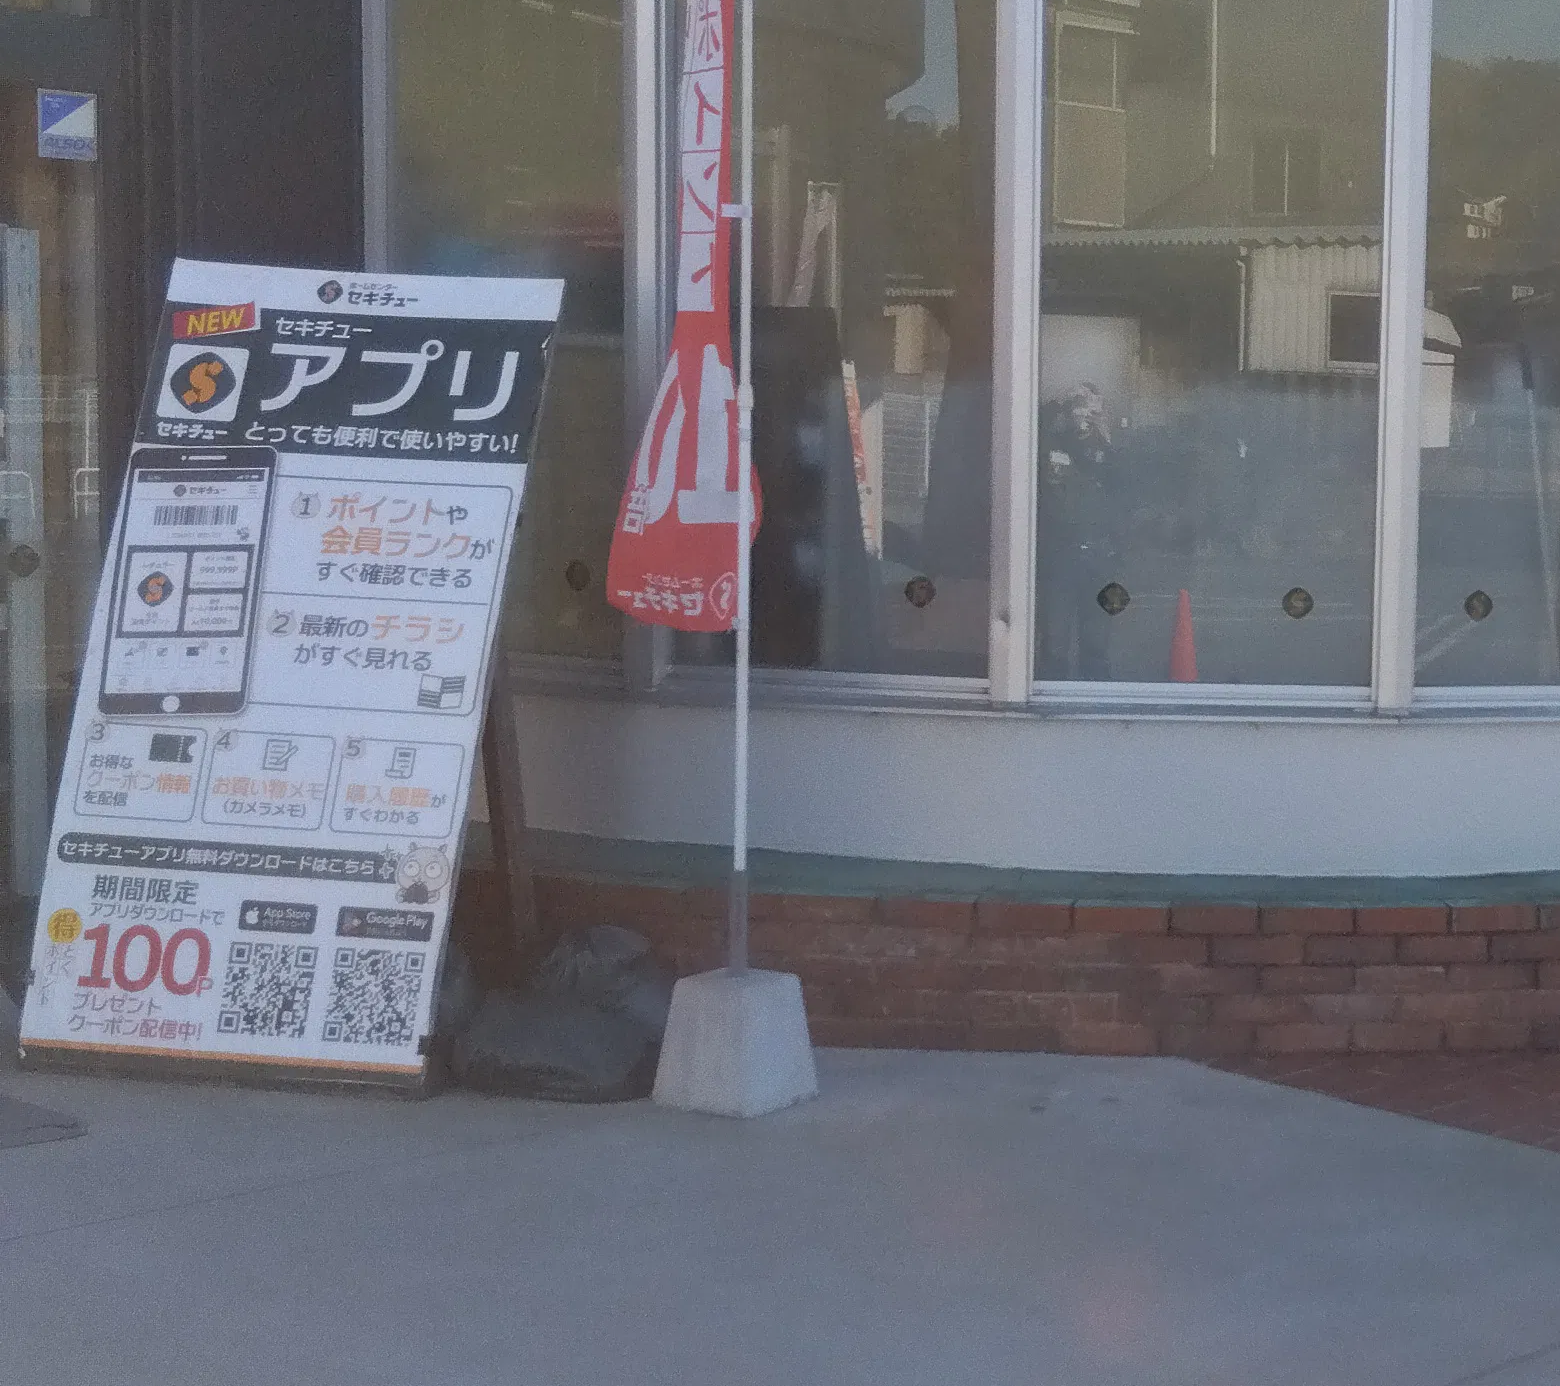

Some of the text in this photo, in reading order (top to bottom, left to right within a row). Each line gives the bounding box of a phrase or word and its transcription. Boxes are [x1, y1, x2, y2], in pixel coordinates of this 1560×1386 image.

[348, 291, 418, 307] セキチュー
[186, 307, 245, 335] NEW
[275, 317, 373, 339] セキチュー
[260, 339, 520, 421] アプリ
[156, 421, 228, 440] セキチュー
[327, 491, 468, 525] ポイントや
[320, 525, 495, 560] 会員ランクが
[316, 561, 472, 588] すぐ確認できる
[299, 614, 465, 644] 最新のチラシ
[294, 643, 433, 671] がすぐ見れる
[90, 754, 134, 770] お得な
[83, 790, 128, 806] を配信
[213, 776, 324, 800] お買い物メモ
[344, 806, 420, 825] すぐわかる
[62, 840, 375, 875] セキチューアプリ無料ダウンロードはこちら
[90, 874, 199, 905] 期間限定
[88, 902, 225, 926] アプリダウンロードで
[366, 912, 428, 930] Google Play
[72, 992, 162, 1016] プレゼント
[67, 1013, 203, 1041] クーポン配信中!
